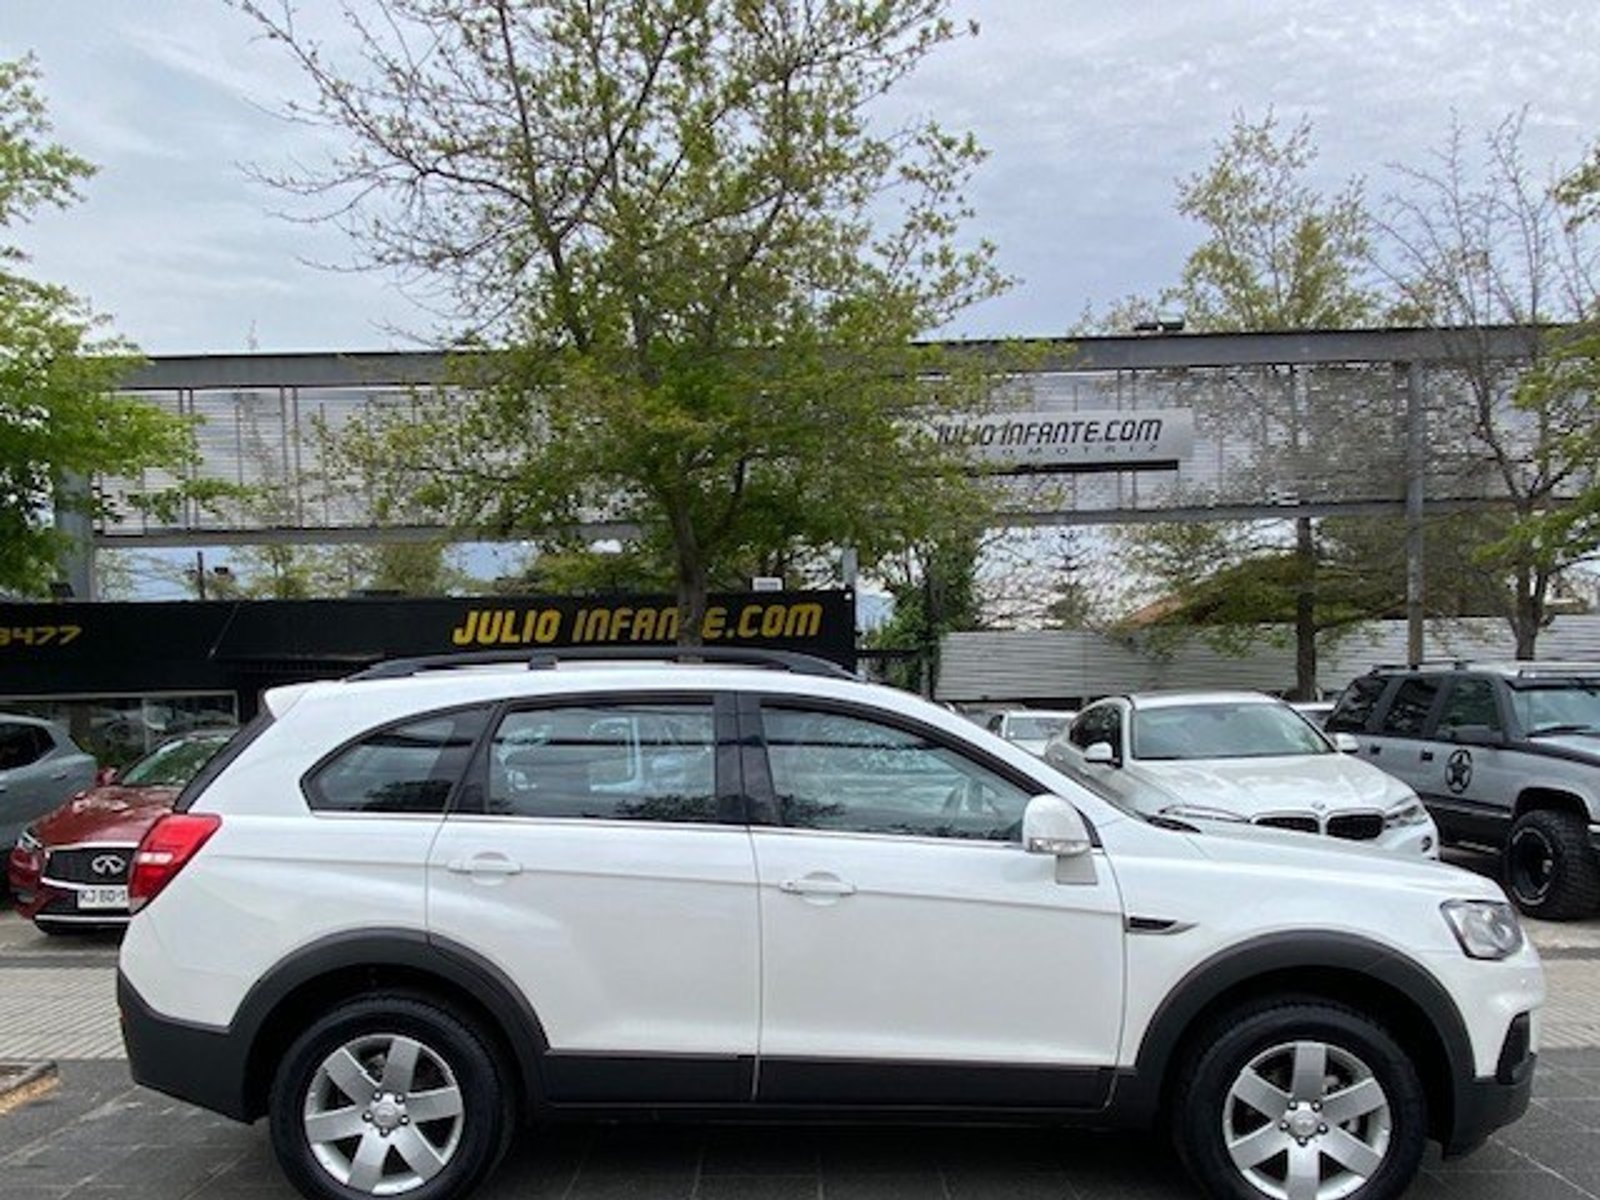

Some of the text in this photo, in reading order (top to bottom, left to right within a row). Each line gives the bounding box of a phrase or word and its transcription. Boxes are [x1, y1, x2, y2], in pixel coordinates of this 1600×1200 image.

[1000, 418, 1162, 445] INFANTE.COM
[453, 603, 824, 644] JULIO INFANE.COM
